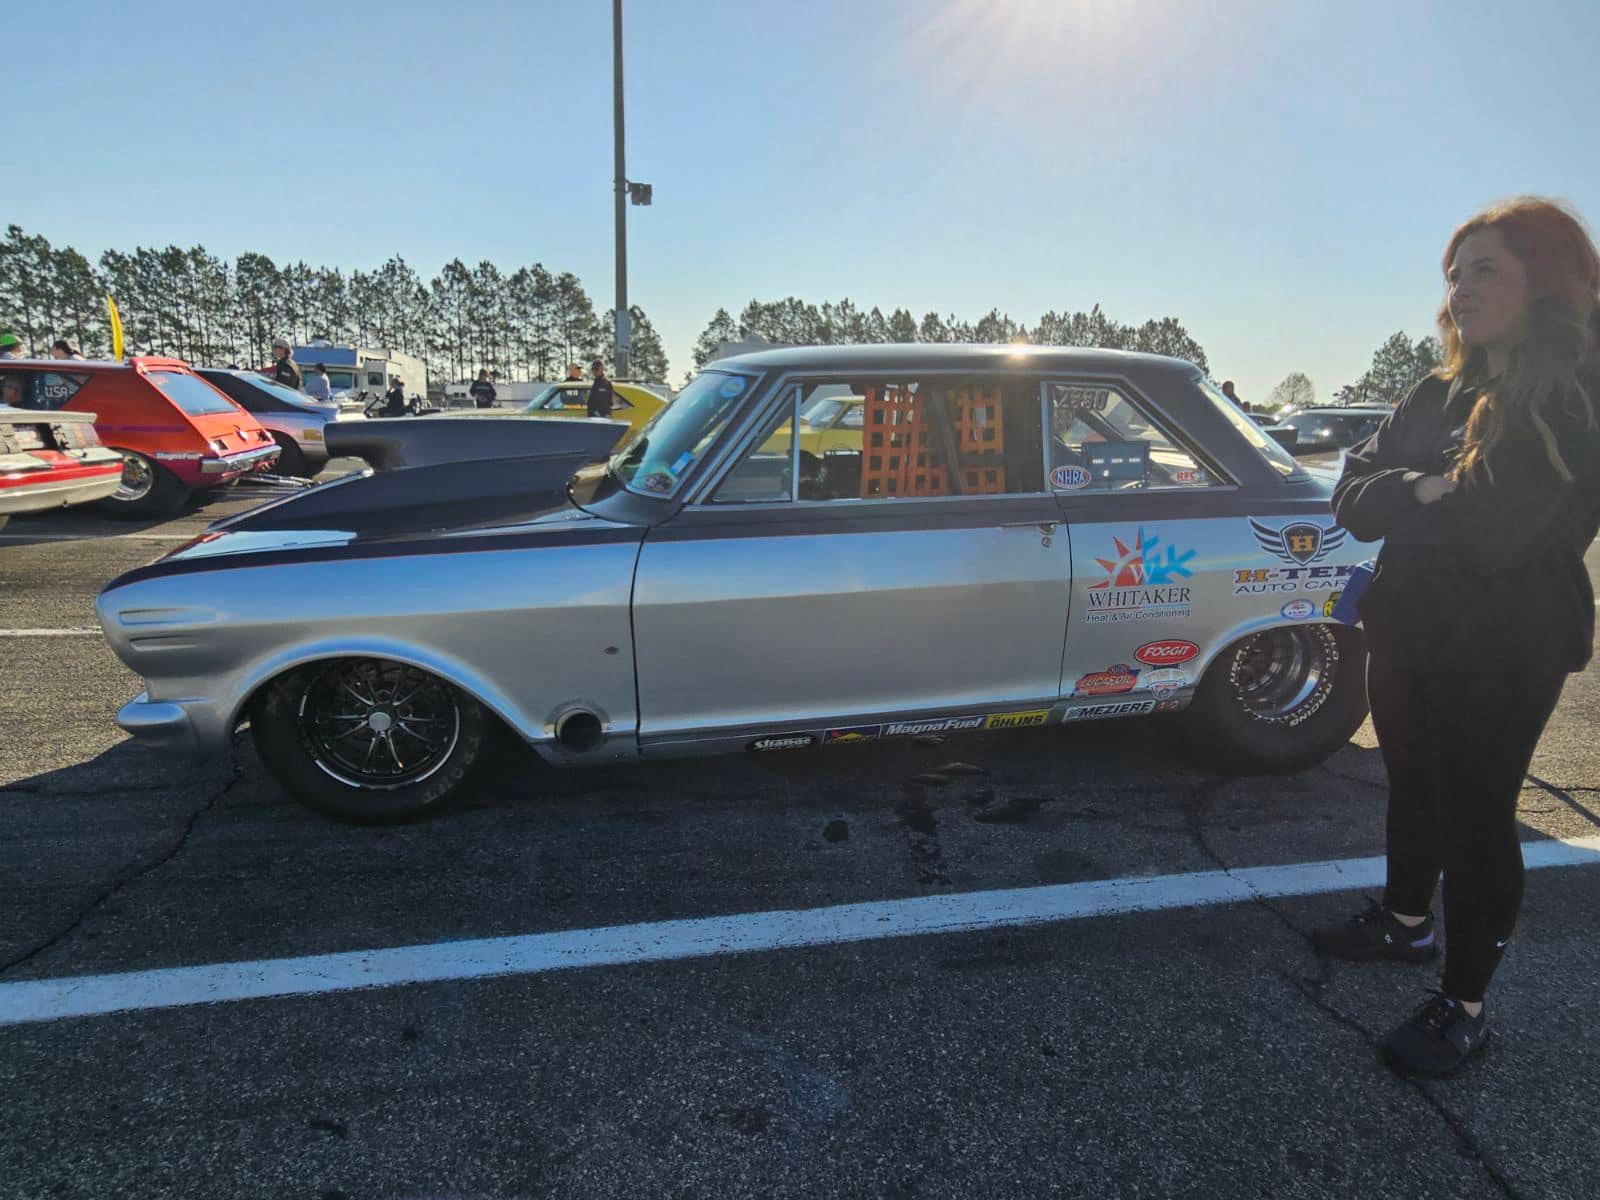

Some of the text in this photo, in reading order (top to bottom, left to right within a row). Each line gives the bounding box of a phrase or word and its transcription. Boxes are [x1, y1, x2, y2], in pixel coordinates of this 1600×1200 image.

[44, 386, 69, 399] USA
[1056, 469, 1085, 484] NHRA
[1290, 535, 1315, 553] H
[1129, 563, 1154, 584] W
[1235, 582, 1297, 594] AUTO
[1088, 587, 1192, 607] WHITAKER
[1086, 607, 1192, 623] Heat & Air Conditioning
[1143, 645, 1191, 657] FOGGIT
[1079, 701, 1154, 717] MEZIERE
[1288, 682, 1334, 727] RACING
[885, 716, 984, 736] MagnaFuel
